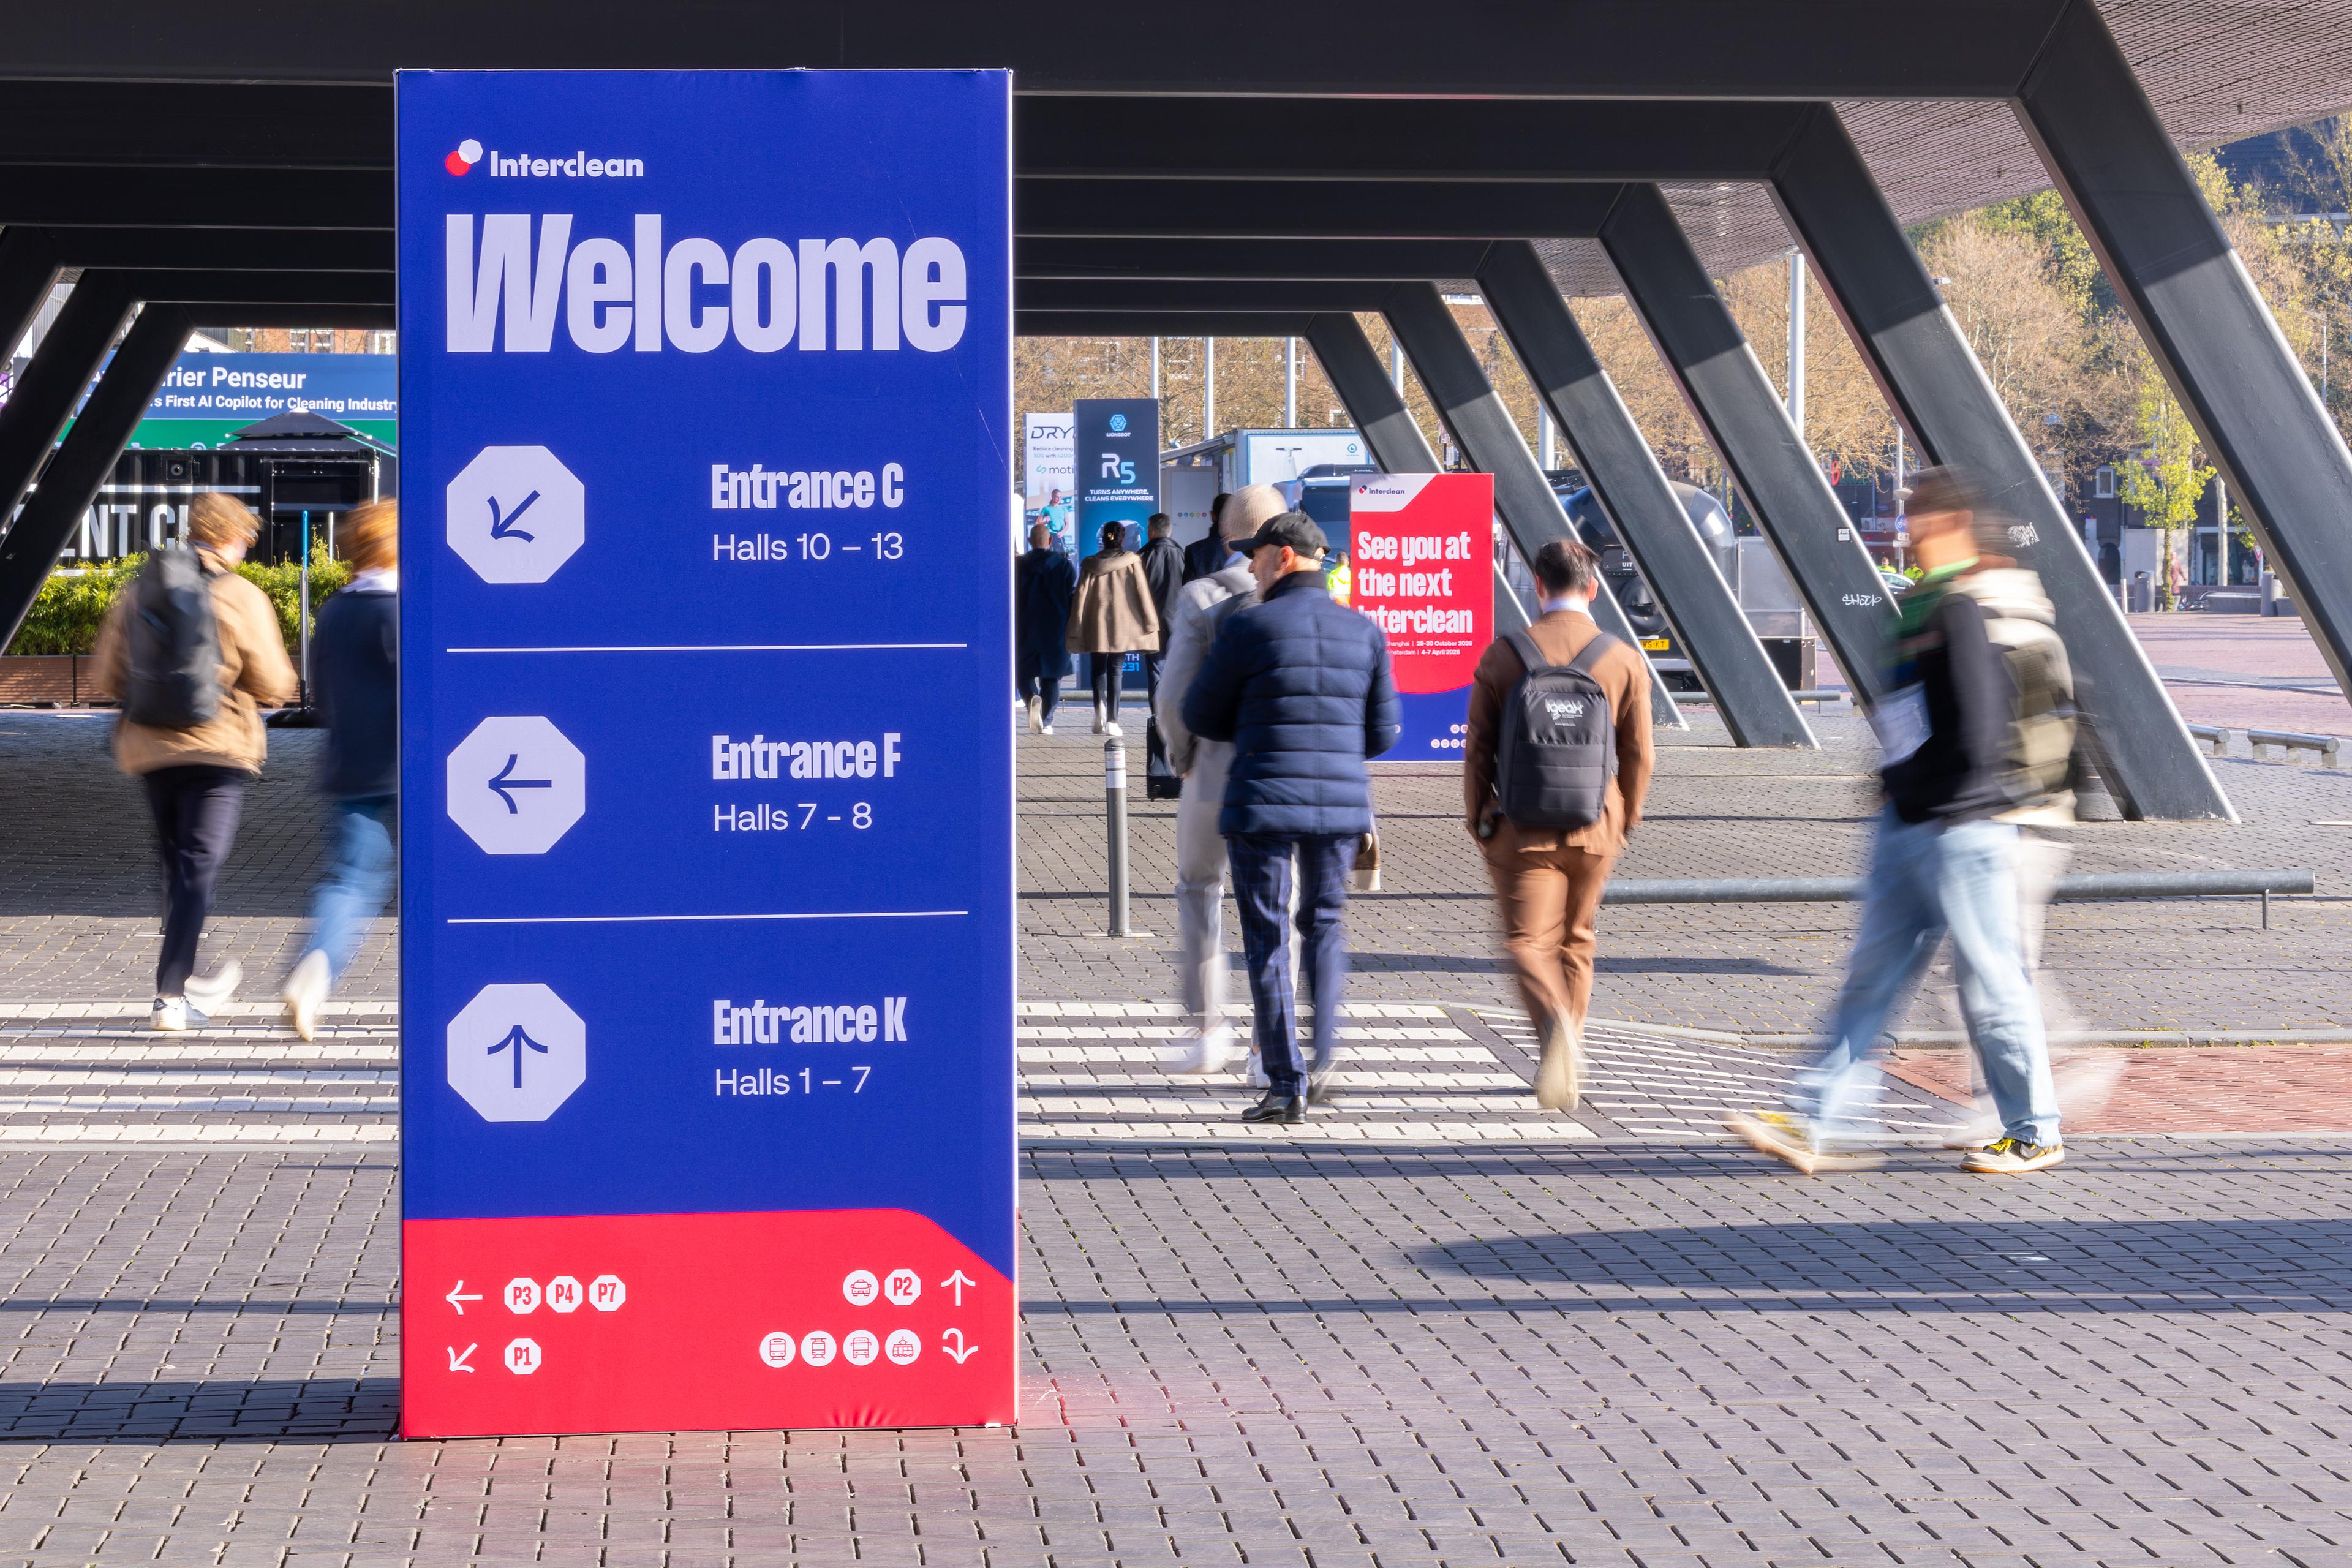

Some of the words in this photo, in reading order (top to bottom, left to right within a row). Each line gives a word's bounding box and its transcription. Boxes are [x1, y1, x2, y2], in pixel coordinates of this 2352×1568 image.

[491, 151, 643, 176] Interclean
[447, 214, 966, 353] Welcome
[162, 367, 206, 387] rier
[213, 368, 307, 389] Penseur
[165, 395, 195, 407] First
[197, 395, 213, 407] AI
[215, 396, 262, 410] Copilot
[265, 396, 285, 409] for
[287, 397, 345, 413] Cleaning
[1031, 426, 1074, 439] DRY
[1102, 453, 1136, 484] R5
[712, 464, 875, 509] Entrance
[883, 462, 903, 508] C
[714, 533, 788, 560] Halls
[797, 533, 831, 560] 10
[872, 532, 903, 559] 13
[1358, 531, 1398, 560] See
[1402, 536, 1442, 567] you
[1446, 531, 1471, 560] at
[1358, 568, 1396, 597] the
[1400, 568, 1452, 597] next
[713, 734, 877, 780] Entrance
[884, 733, 901, 777] F
[715, 804, 788, 831] Halls
[798, 803, 817, 830] 7
[853, 802, 872, 829] 8
[714, 999, 877, 1045] Entrance
[884, 997, 907, 1041] K
[716, 1068, 790, 1096] Halls
[799, 1068, 810, 1094] 1
[852, 1066, 871, 1093] 7
[513, 1286, 532, 1305] P3
[556, 1284, 574, 1304] P4
[598, 1283, 617, 1303] P7
[893, 1276, 913, 1297] P2
[513, 1348, 532, 1367] P1
